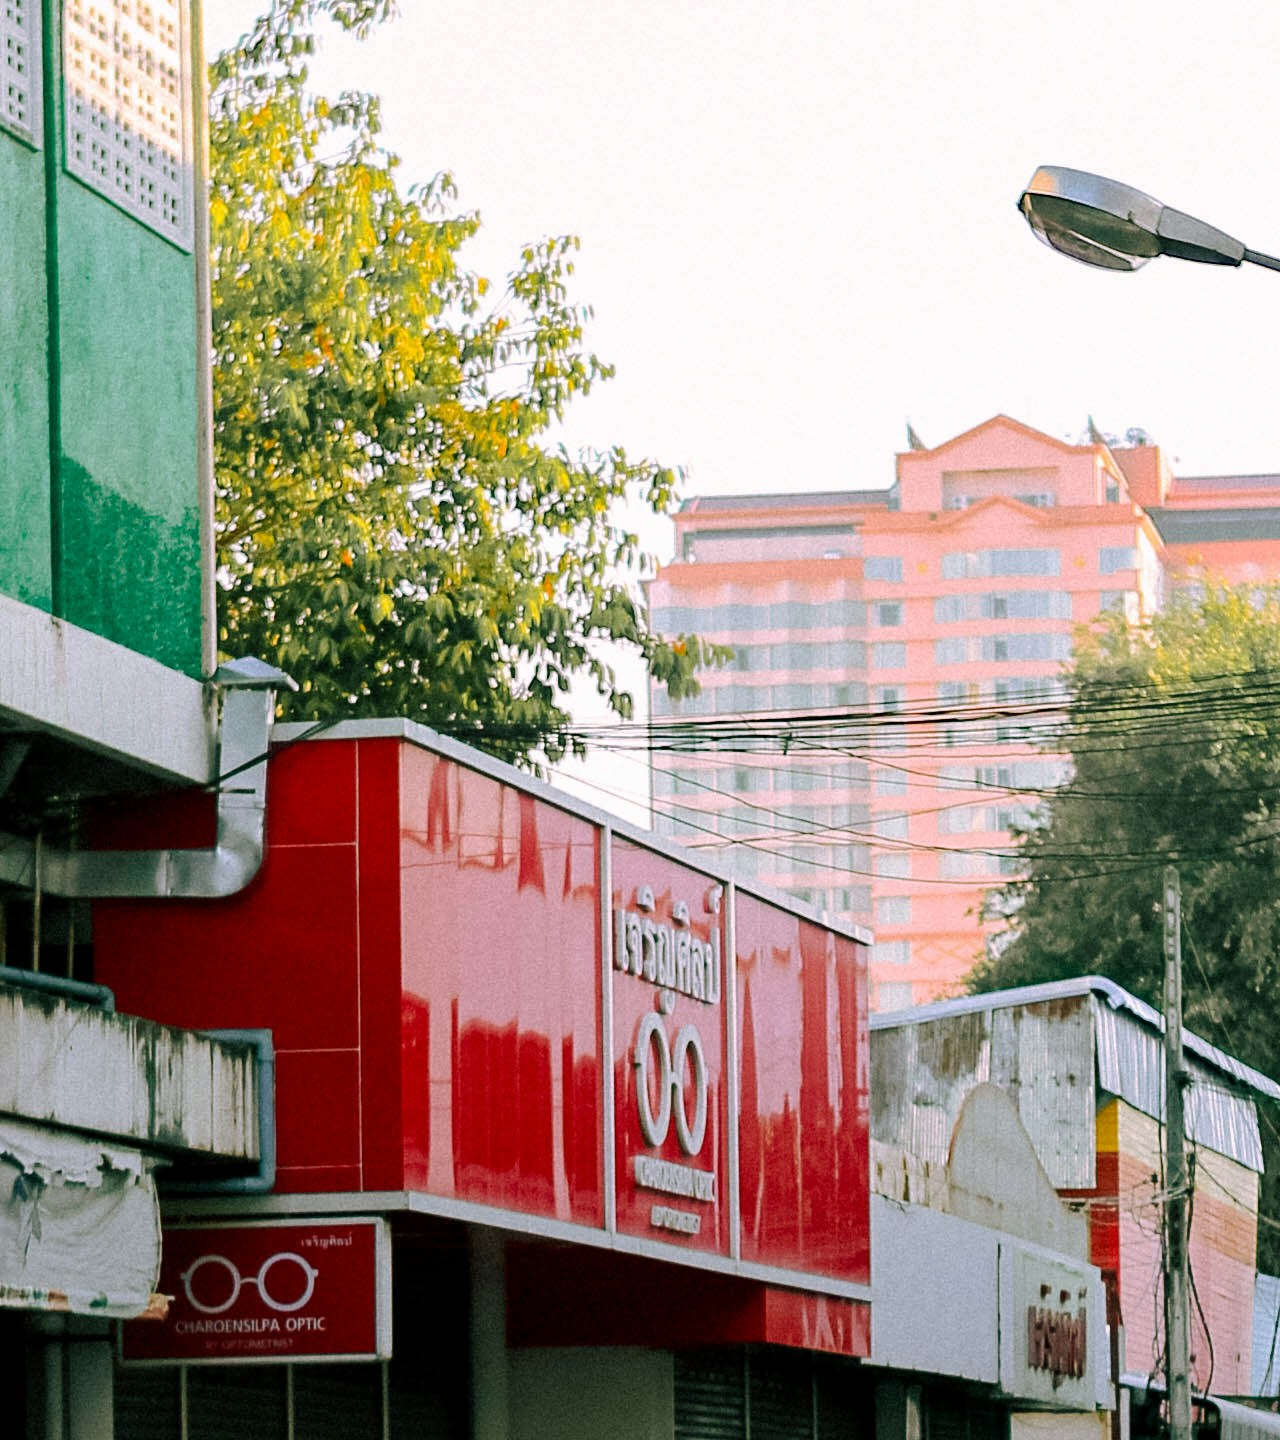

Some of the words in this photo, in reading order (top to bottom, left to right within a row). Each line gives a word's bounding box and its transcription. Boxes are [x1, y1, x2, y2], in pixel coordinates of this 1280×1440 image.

[615, 884, 723, 1016] เจริญศิลป์
[175, 1317, 281, 1335] CHAROENSILPA
[285, 1316, 326, 1332] OPTIC
